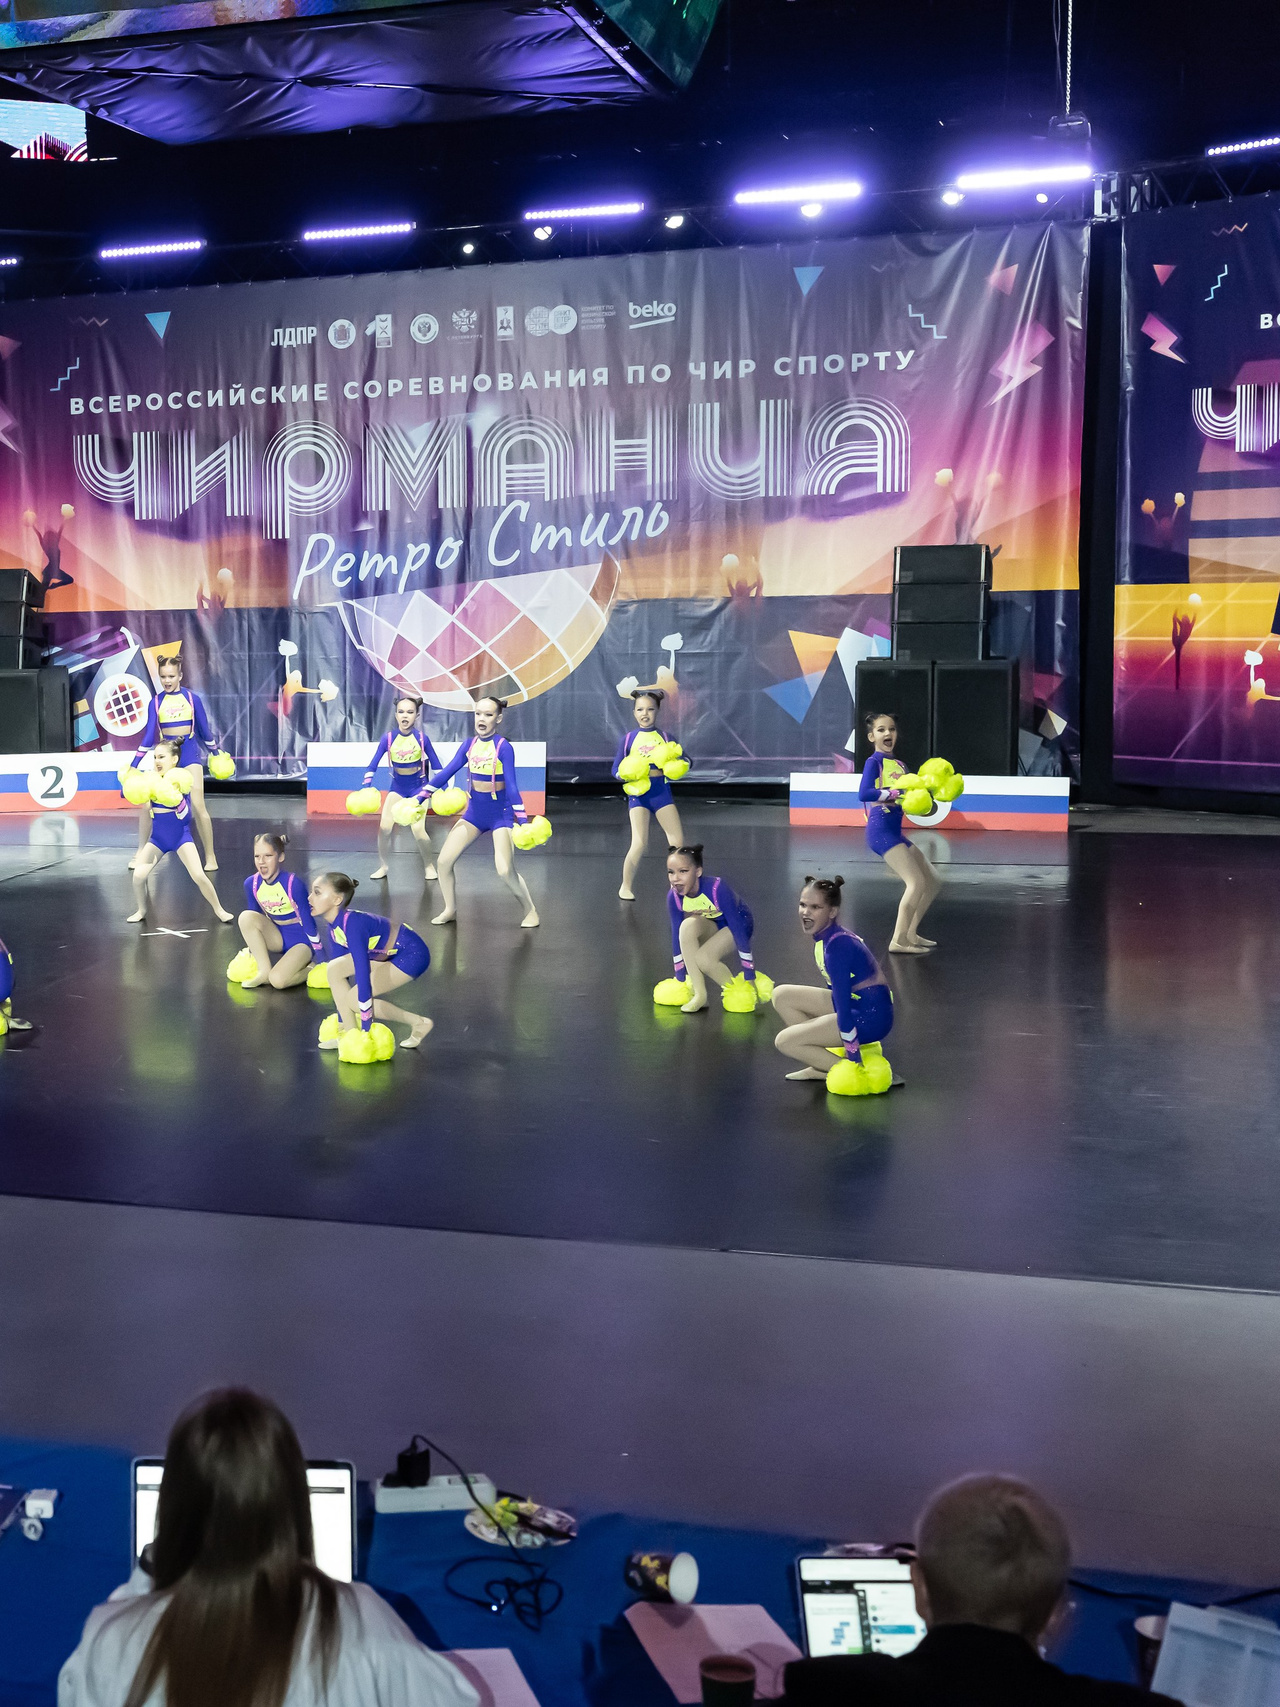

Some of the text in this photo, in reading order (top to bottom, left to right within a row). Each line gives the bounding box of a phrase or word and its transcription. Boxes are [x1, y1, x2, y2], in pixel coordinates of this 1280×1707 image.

[629, 300, 677, 319] beko
[1260, 313, 1280, 329] В
[271, 326, 317, 348] ЛДПР
[70, 349, 916, 415] ВСЕРОССИЙСКИЕ СОРЕВНОВАНИЯ ПО ЧИР СПОРТУ
[293, 499, 670, 600] Ретро Стиль
[40, 765, 65, 799] 2
